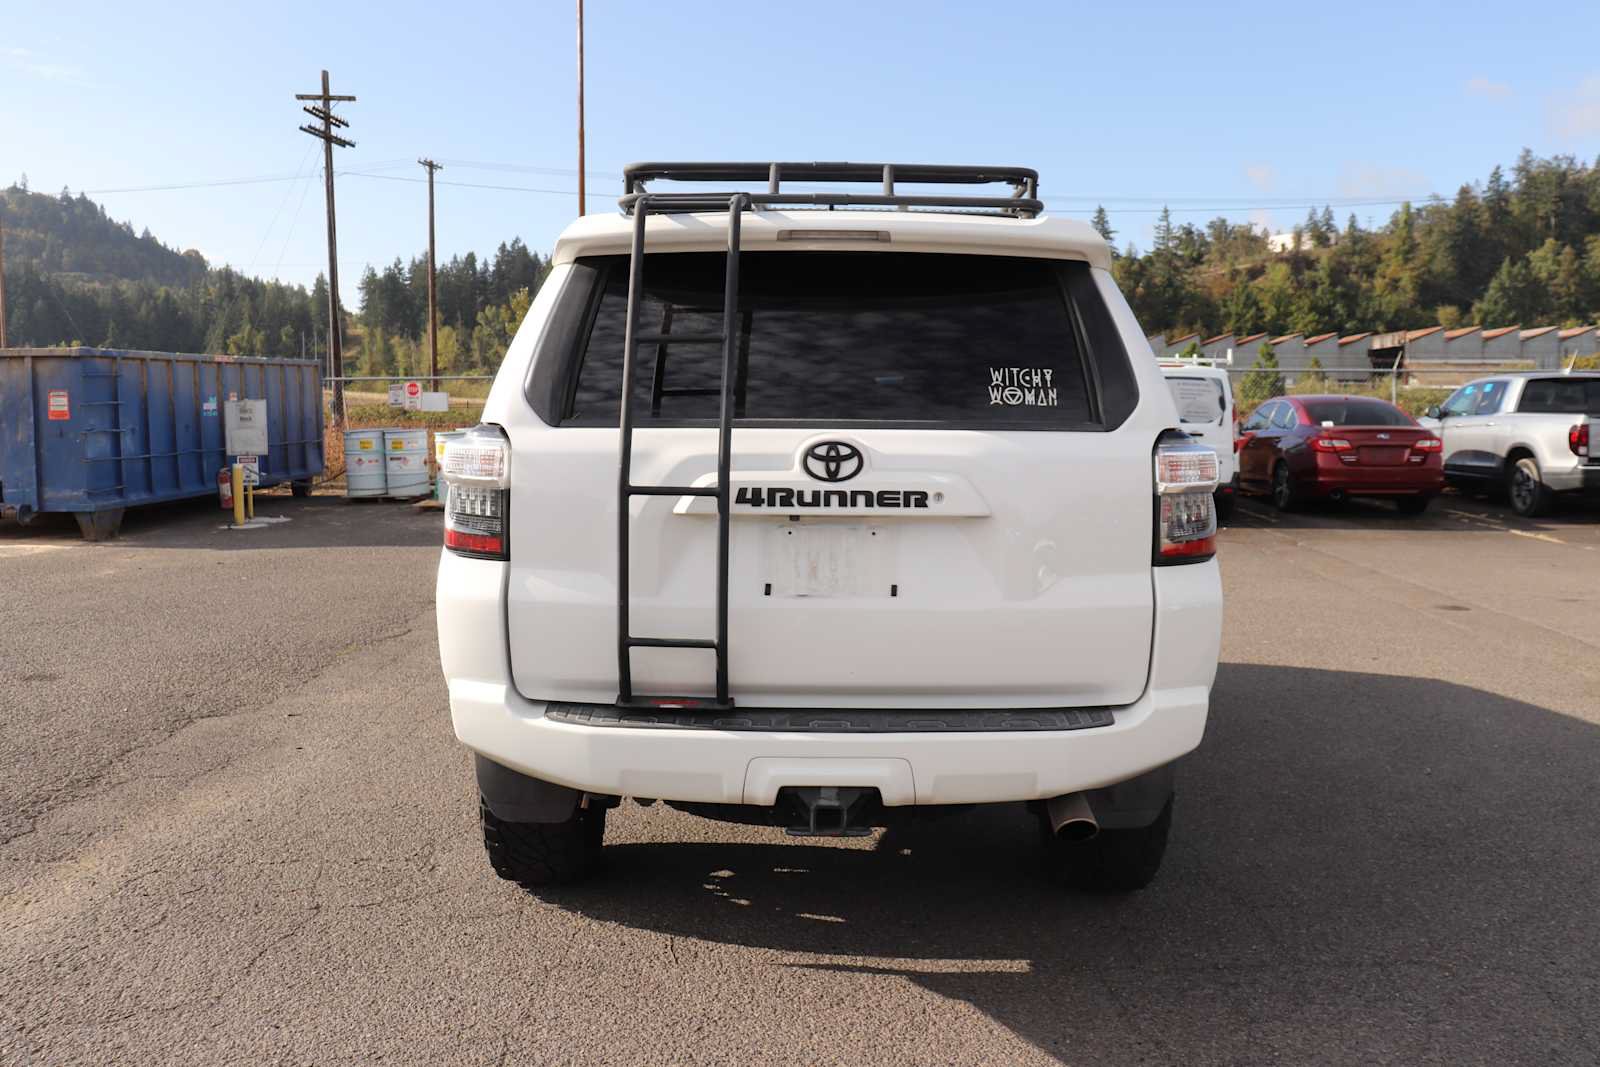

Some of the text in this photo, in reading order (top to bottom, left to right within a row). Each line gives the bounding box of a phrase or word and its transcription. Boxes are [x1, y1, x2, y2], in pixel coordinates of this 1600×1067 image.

[989, 367, 1053, 387] WITCHY
[988, 386, 1057, 406] WOMAN
[735, 487, 929, 508] 4RUNNER
